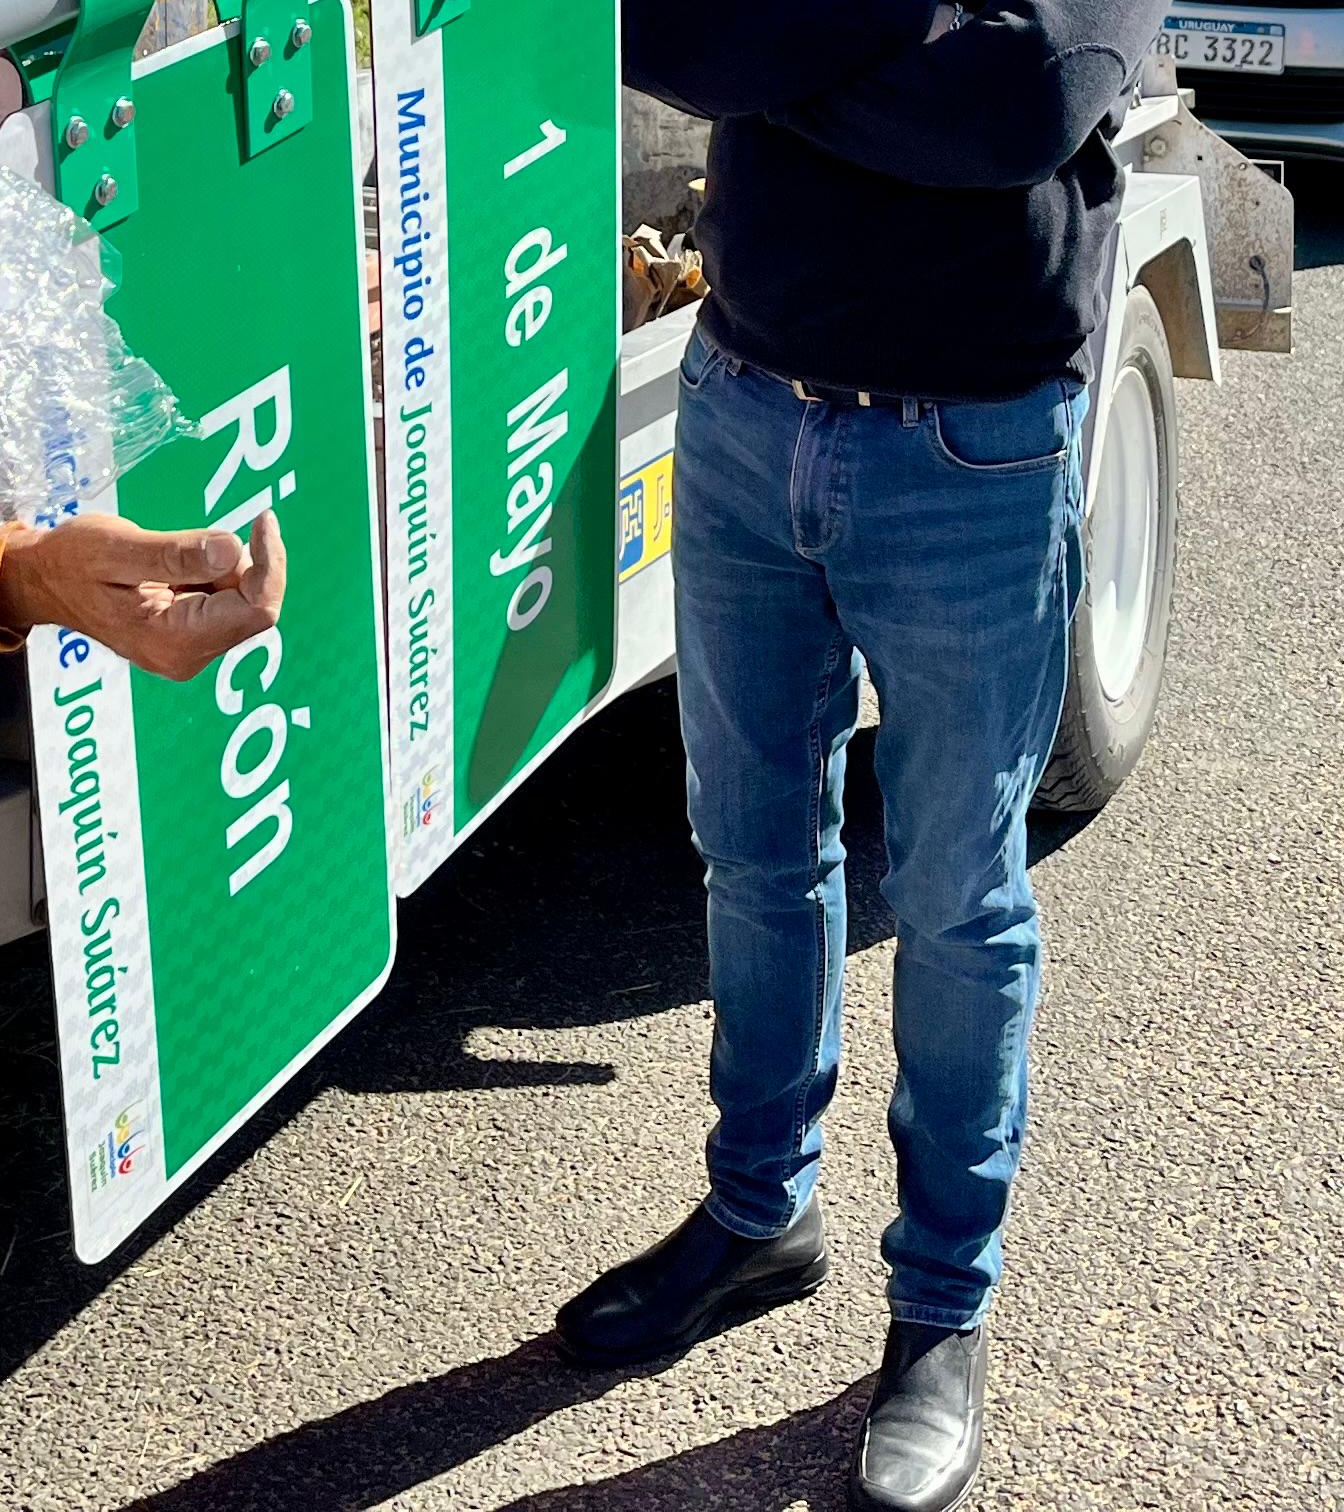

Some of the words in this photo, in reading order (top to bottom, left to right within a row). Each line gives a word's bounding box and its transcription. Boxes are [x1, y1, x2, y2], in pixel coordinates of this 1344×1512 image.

[1177, 19, 1236, 33] URUGUAY
[1203, 34, 1274, 67] 3322
[394, 87, 432, 321] Municipio
[504, 119, 567, 178] 1
[505, 227, 568, 346] de
[403, 336, 435, 391] de
[399, 402, 435, 582] Joaquín
[490, 368, 569, 632] Mayo
[57, 625, 91, 669] e
[200, 363, 311, 896] Ricón
[408, 588, 438, 741] Suárez
[53, 678, 118, 895] Joaquín
[80, 897, 128, 1080] Suárez
